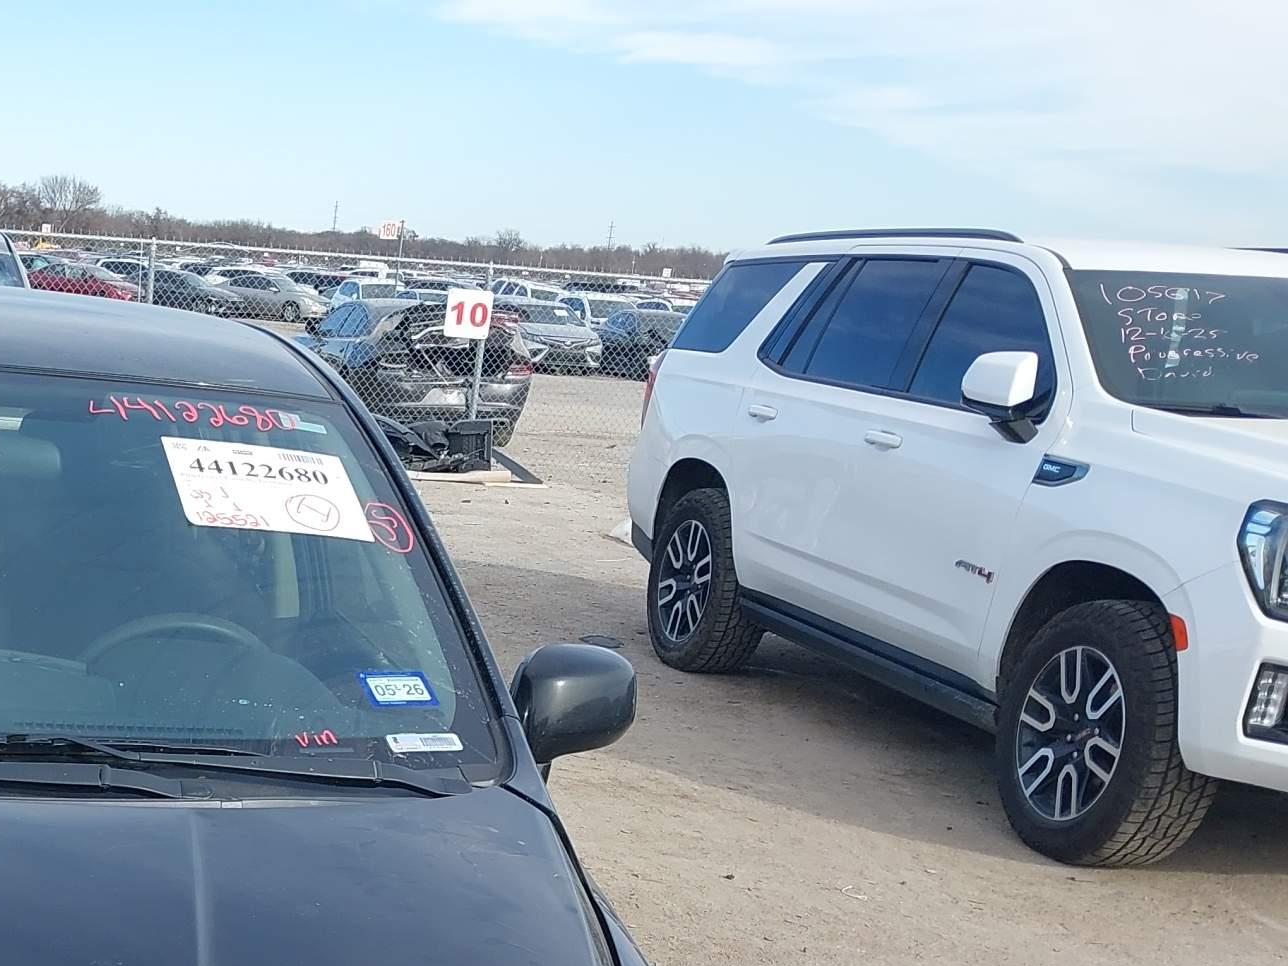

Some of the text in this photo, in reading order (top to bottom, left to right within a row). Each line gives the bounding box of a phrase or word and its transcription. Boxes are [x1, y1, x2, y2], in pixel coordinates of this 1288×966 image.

[450, 301, 489, 328] 10
[188, 456, 329, 486] 44122680
[1042, 463, 1062, 473] GMC
[955, 559, 995, 584] AT4
[374, 684, 396, 697] 05
[402, 683, 425, 696] 26
